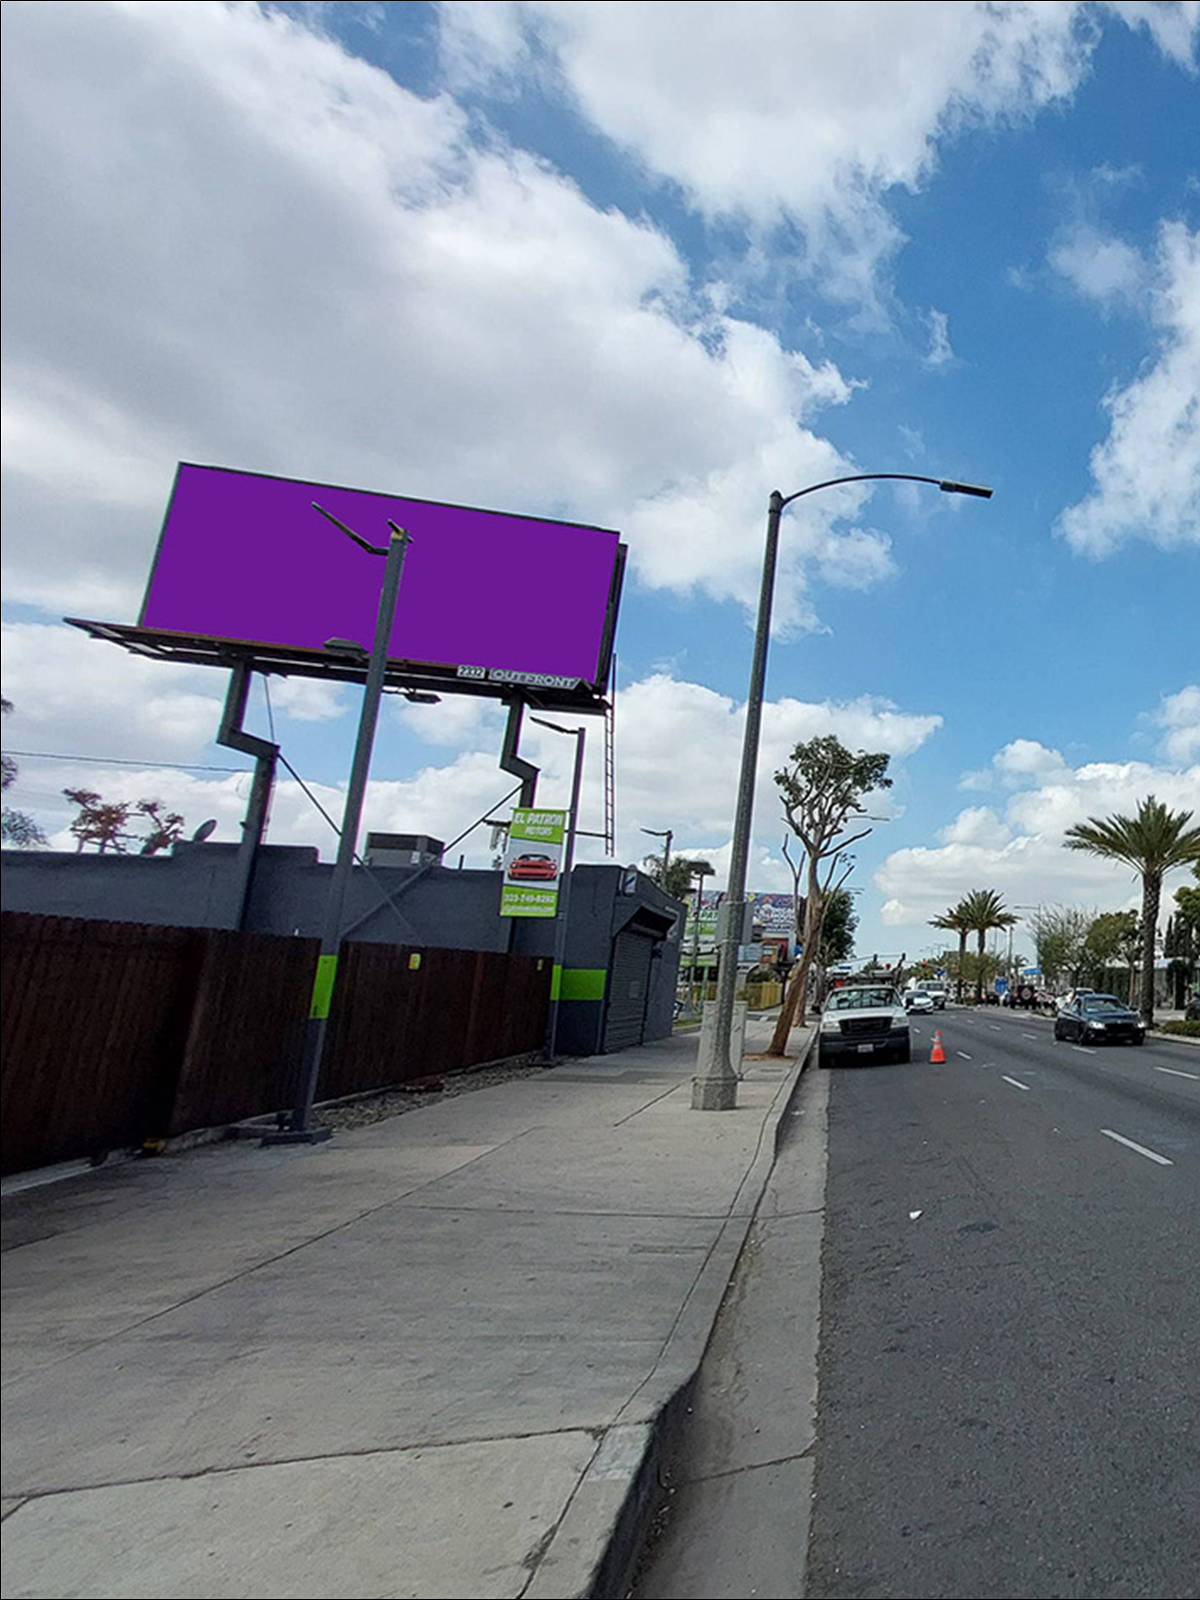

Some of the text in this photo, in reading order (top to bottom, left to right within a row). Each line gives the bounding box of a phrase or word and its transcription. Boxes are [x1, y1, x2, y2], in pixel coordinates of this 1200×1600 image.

[493, 668, 576, 688] OUTFRONT
[514, 812, 562, 826] EL PATRON
